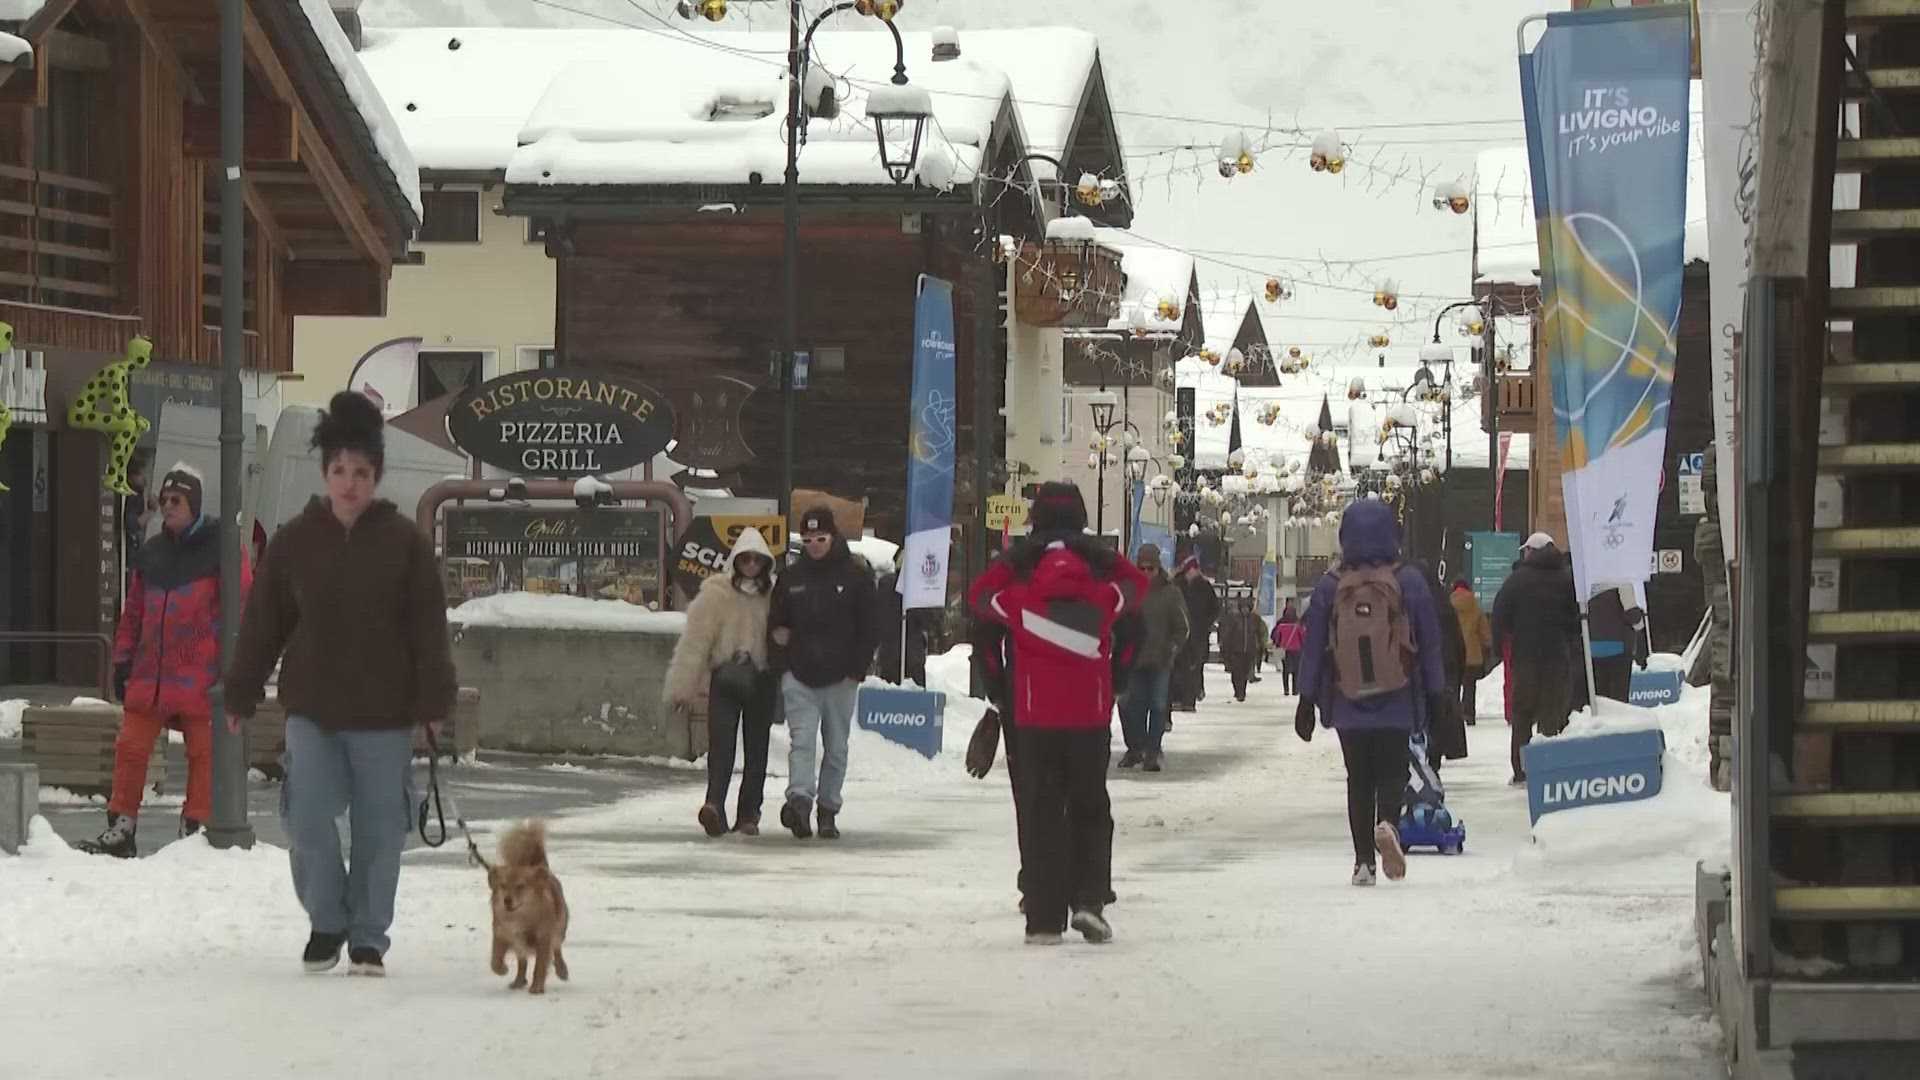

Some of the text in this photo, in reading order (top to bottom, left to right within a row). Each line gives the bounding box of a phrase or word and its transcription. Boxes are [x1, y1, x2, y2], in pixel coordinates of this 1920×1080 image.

[1584, 86, 1630, 109] IT'S
[1559, 106, 1657, 134] LIVIGNO
[1600, 128, 1643, 153] your
[1647, 116, 1681, 139] vibe
[468, 378, 655, 424] RISTORANTE
[499, 422, 624, 445] PIZZERIA
[521, 448, 601, 471] GRILL
[682, 541, 731, 572] SCH
[866, 711, 926, 727] LIVIGNO
[1543, 772, 1646, 804] LIVIGNO
